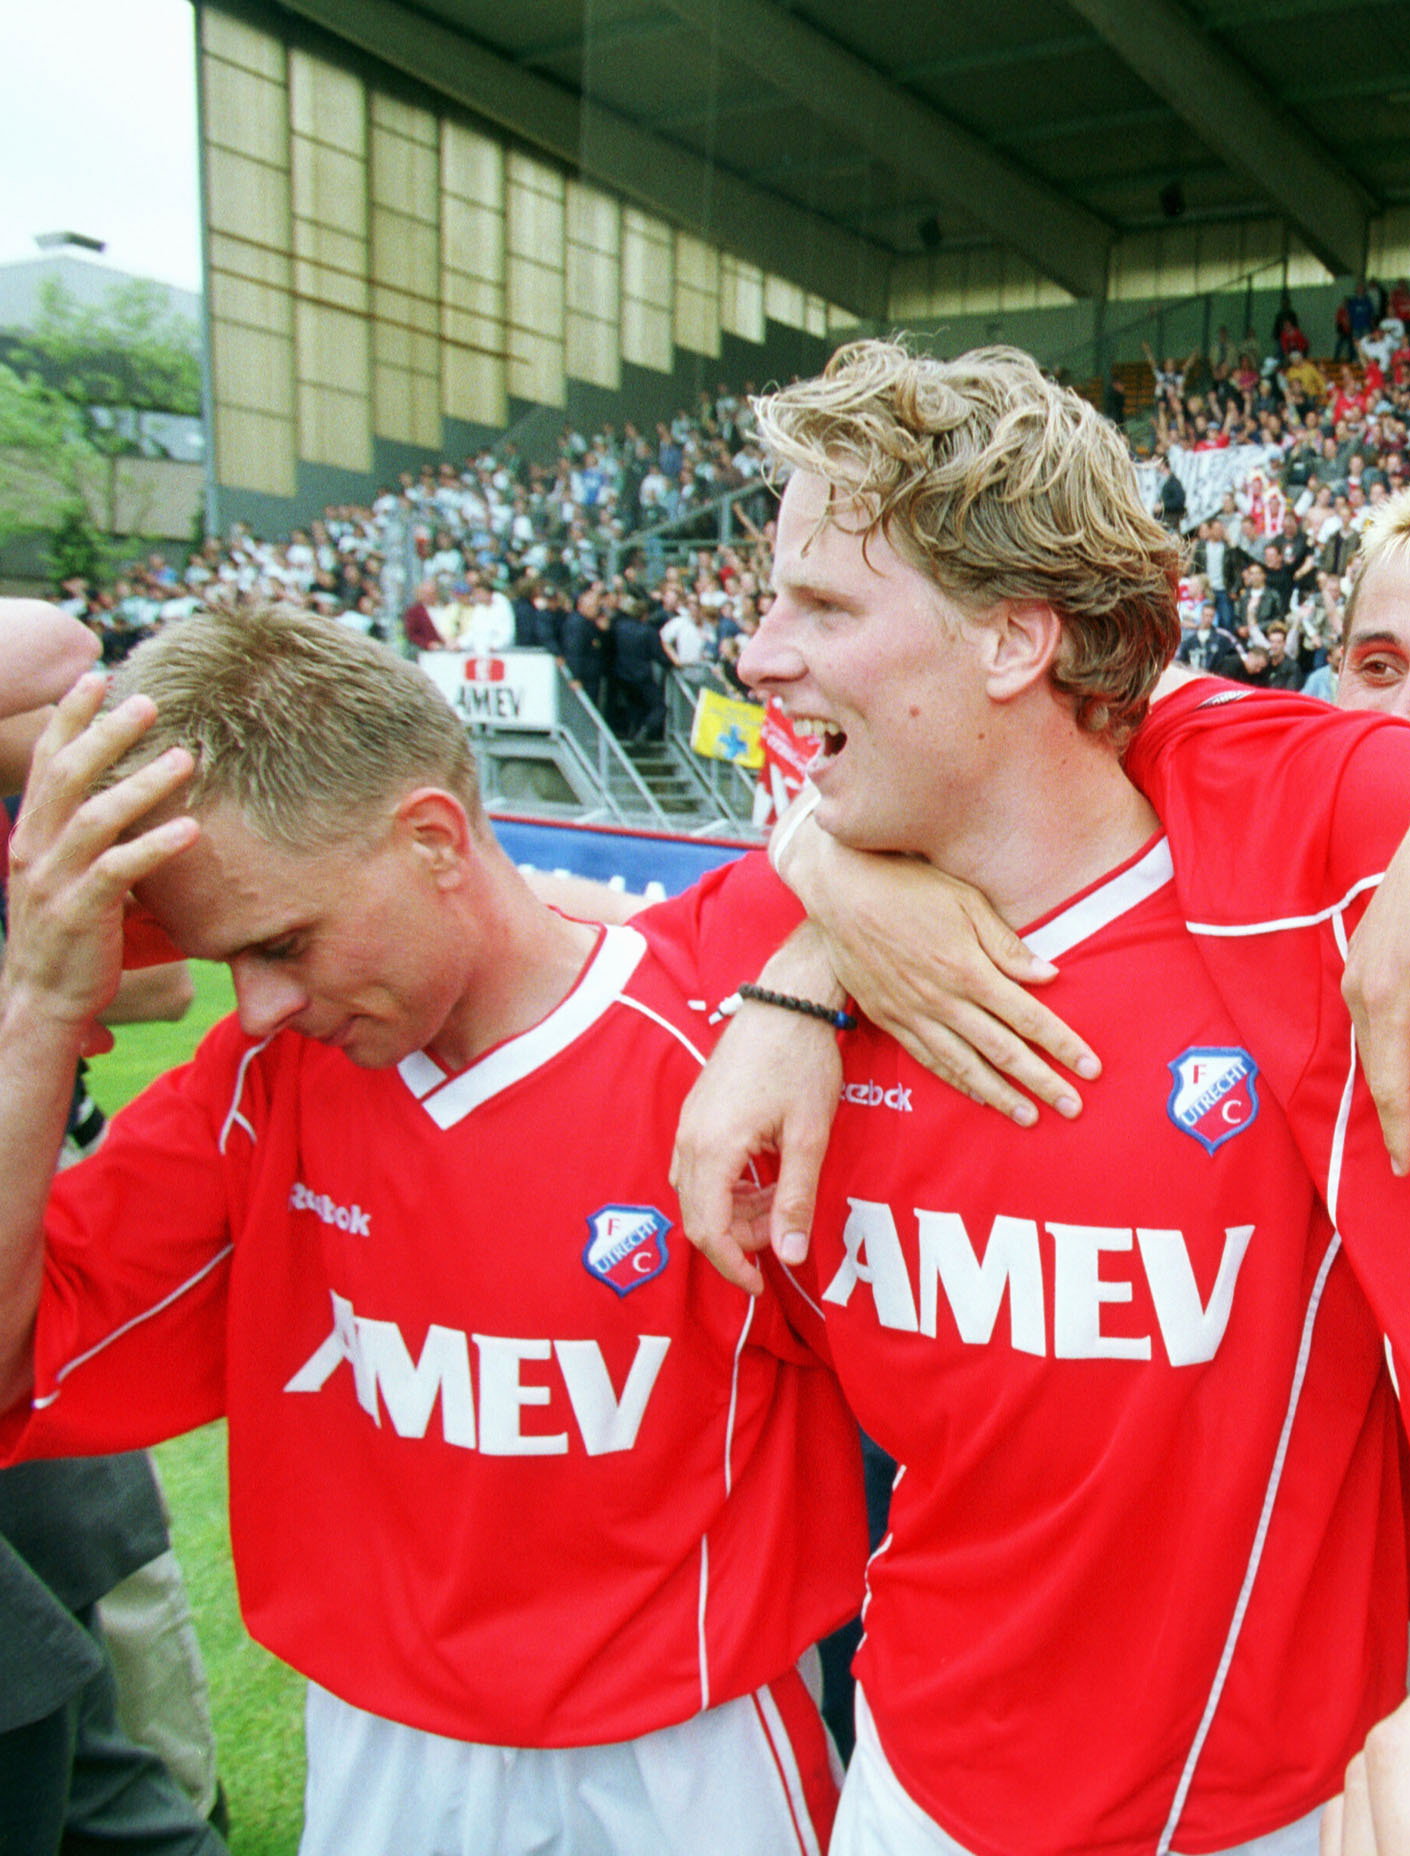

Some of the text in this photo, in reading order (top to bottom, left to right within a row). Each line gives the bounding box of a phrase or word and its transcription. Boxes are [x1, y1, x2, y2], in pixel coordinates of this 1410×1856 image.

[455, 686, 527, 717] AMEV
[1193, 1064, 1208, 1084] F
[841, 1079, 913, 1112] ebok
[1180, 1062, 1248, 1126] UTRECHT
[1221, 1099, 1242, 1124] C
[608, 1217, 621, 1236] F
[594, 1218, 659, 1274] UTRECHT
[632, 1251, 652, 1273] C
[821, 1197, 1256, 1367] AMEV
[283, 1288, 672, 1456] AMEV
